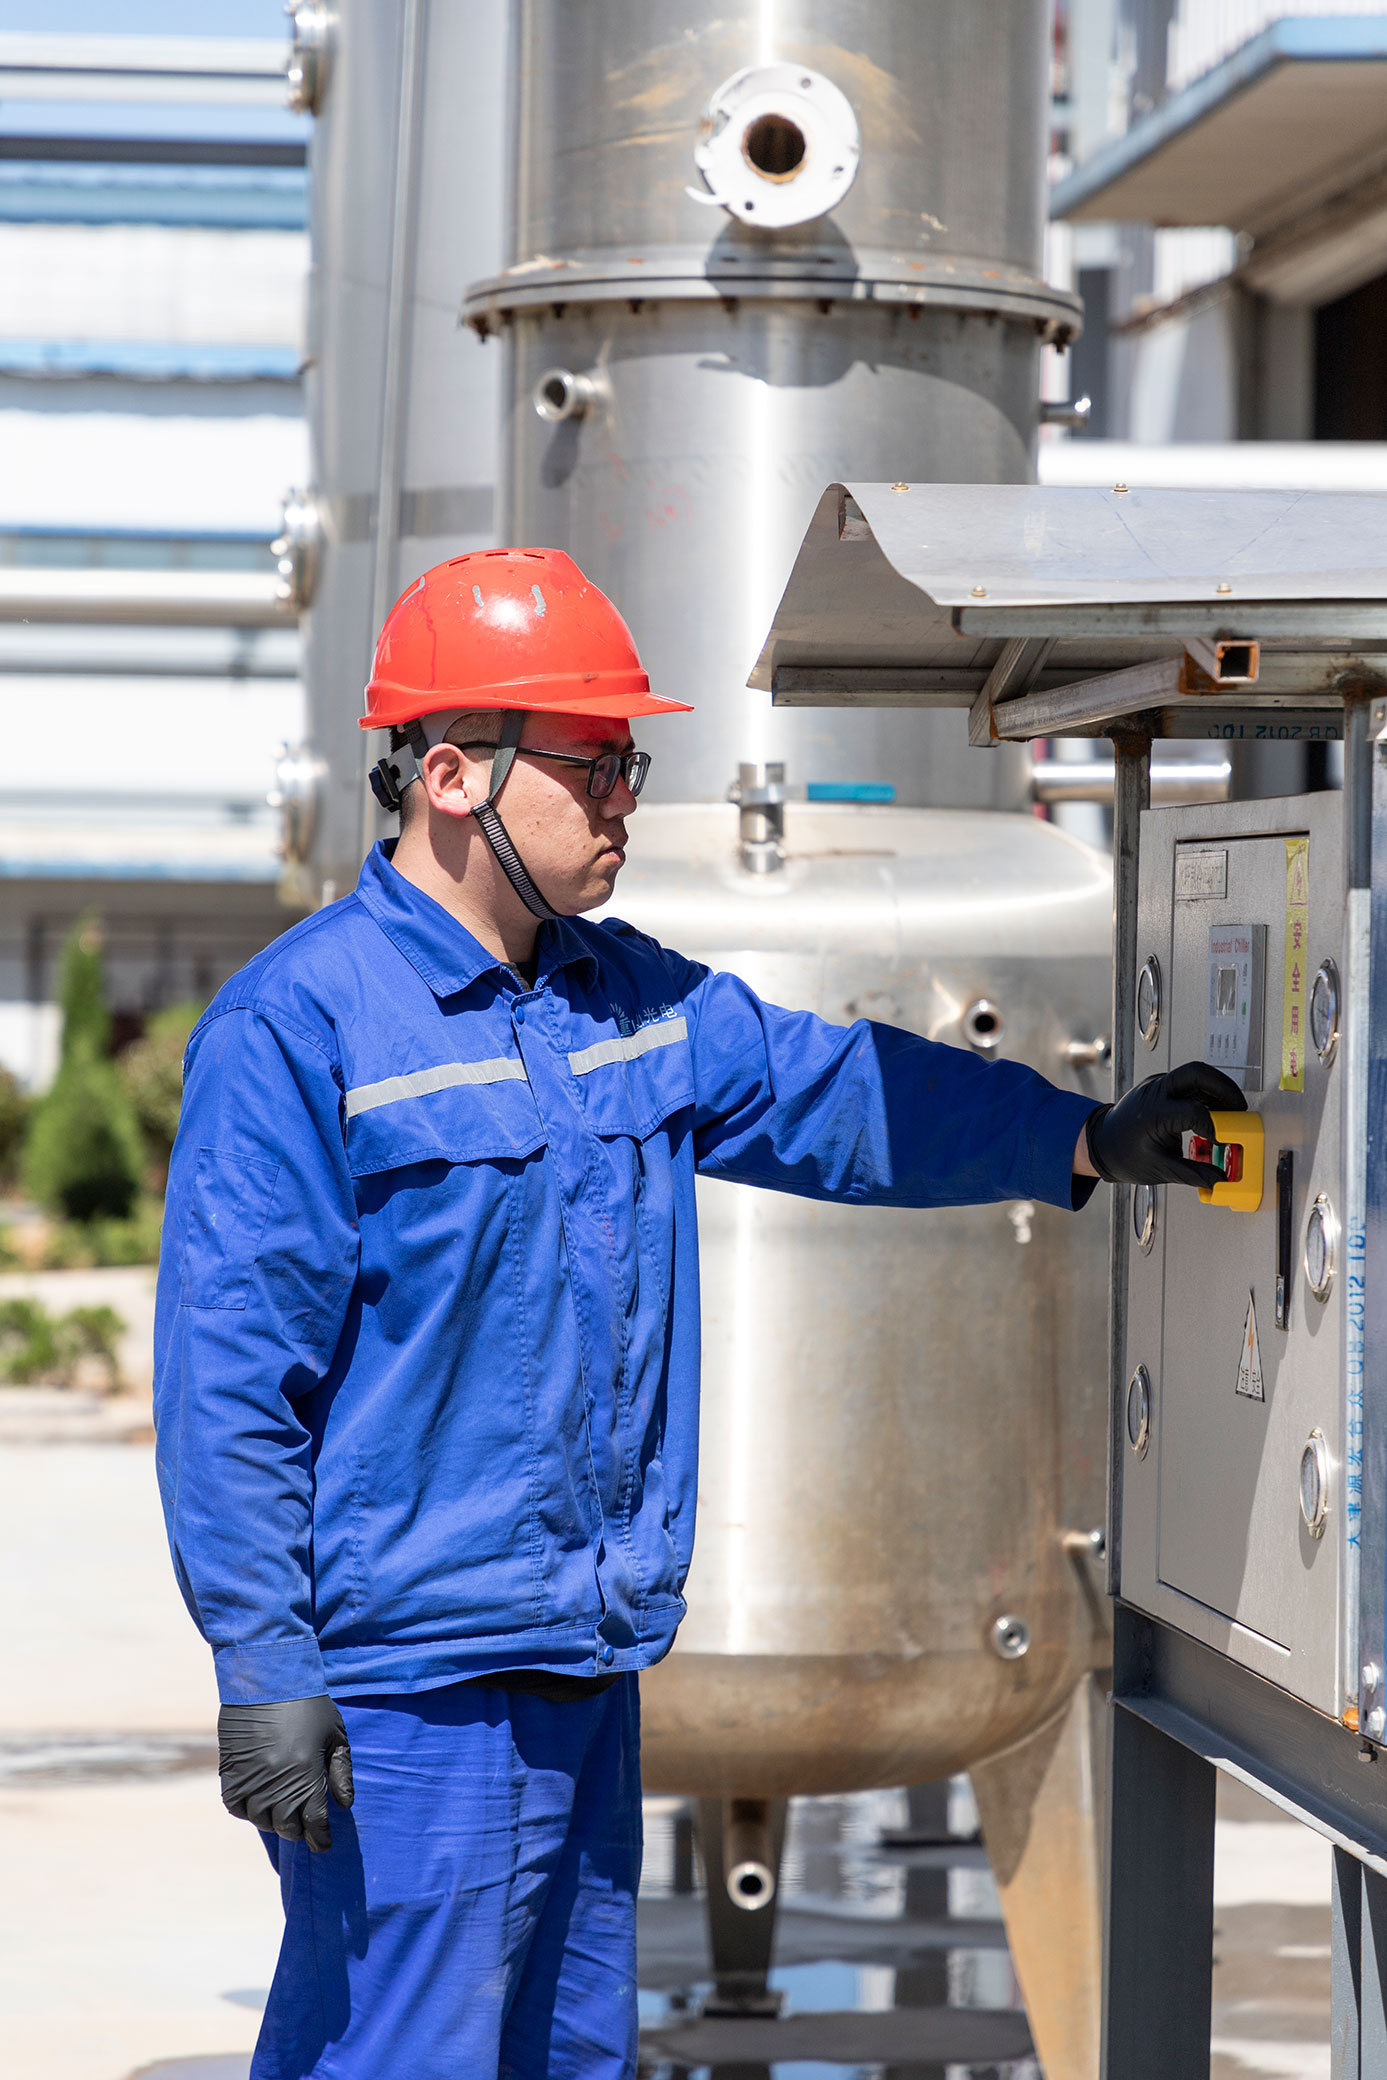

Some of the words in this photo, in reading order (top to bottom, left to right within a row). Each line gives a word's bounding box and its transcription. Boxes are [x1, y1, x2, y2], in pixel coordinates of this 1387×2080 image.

[1256, 726, 1302, 739] 2012
[1289, 919, 1302, 1077] 安全用电
[1348, 1275, 1365, 1331] 2012
